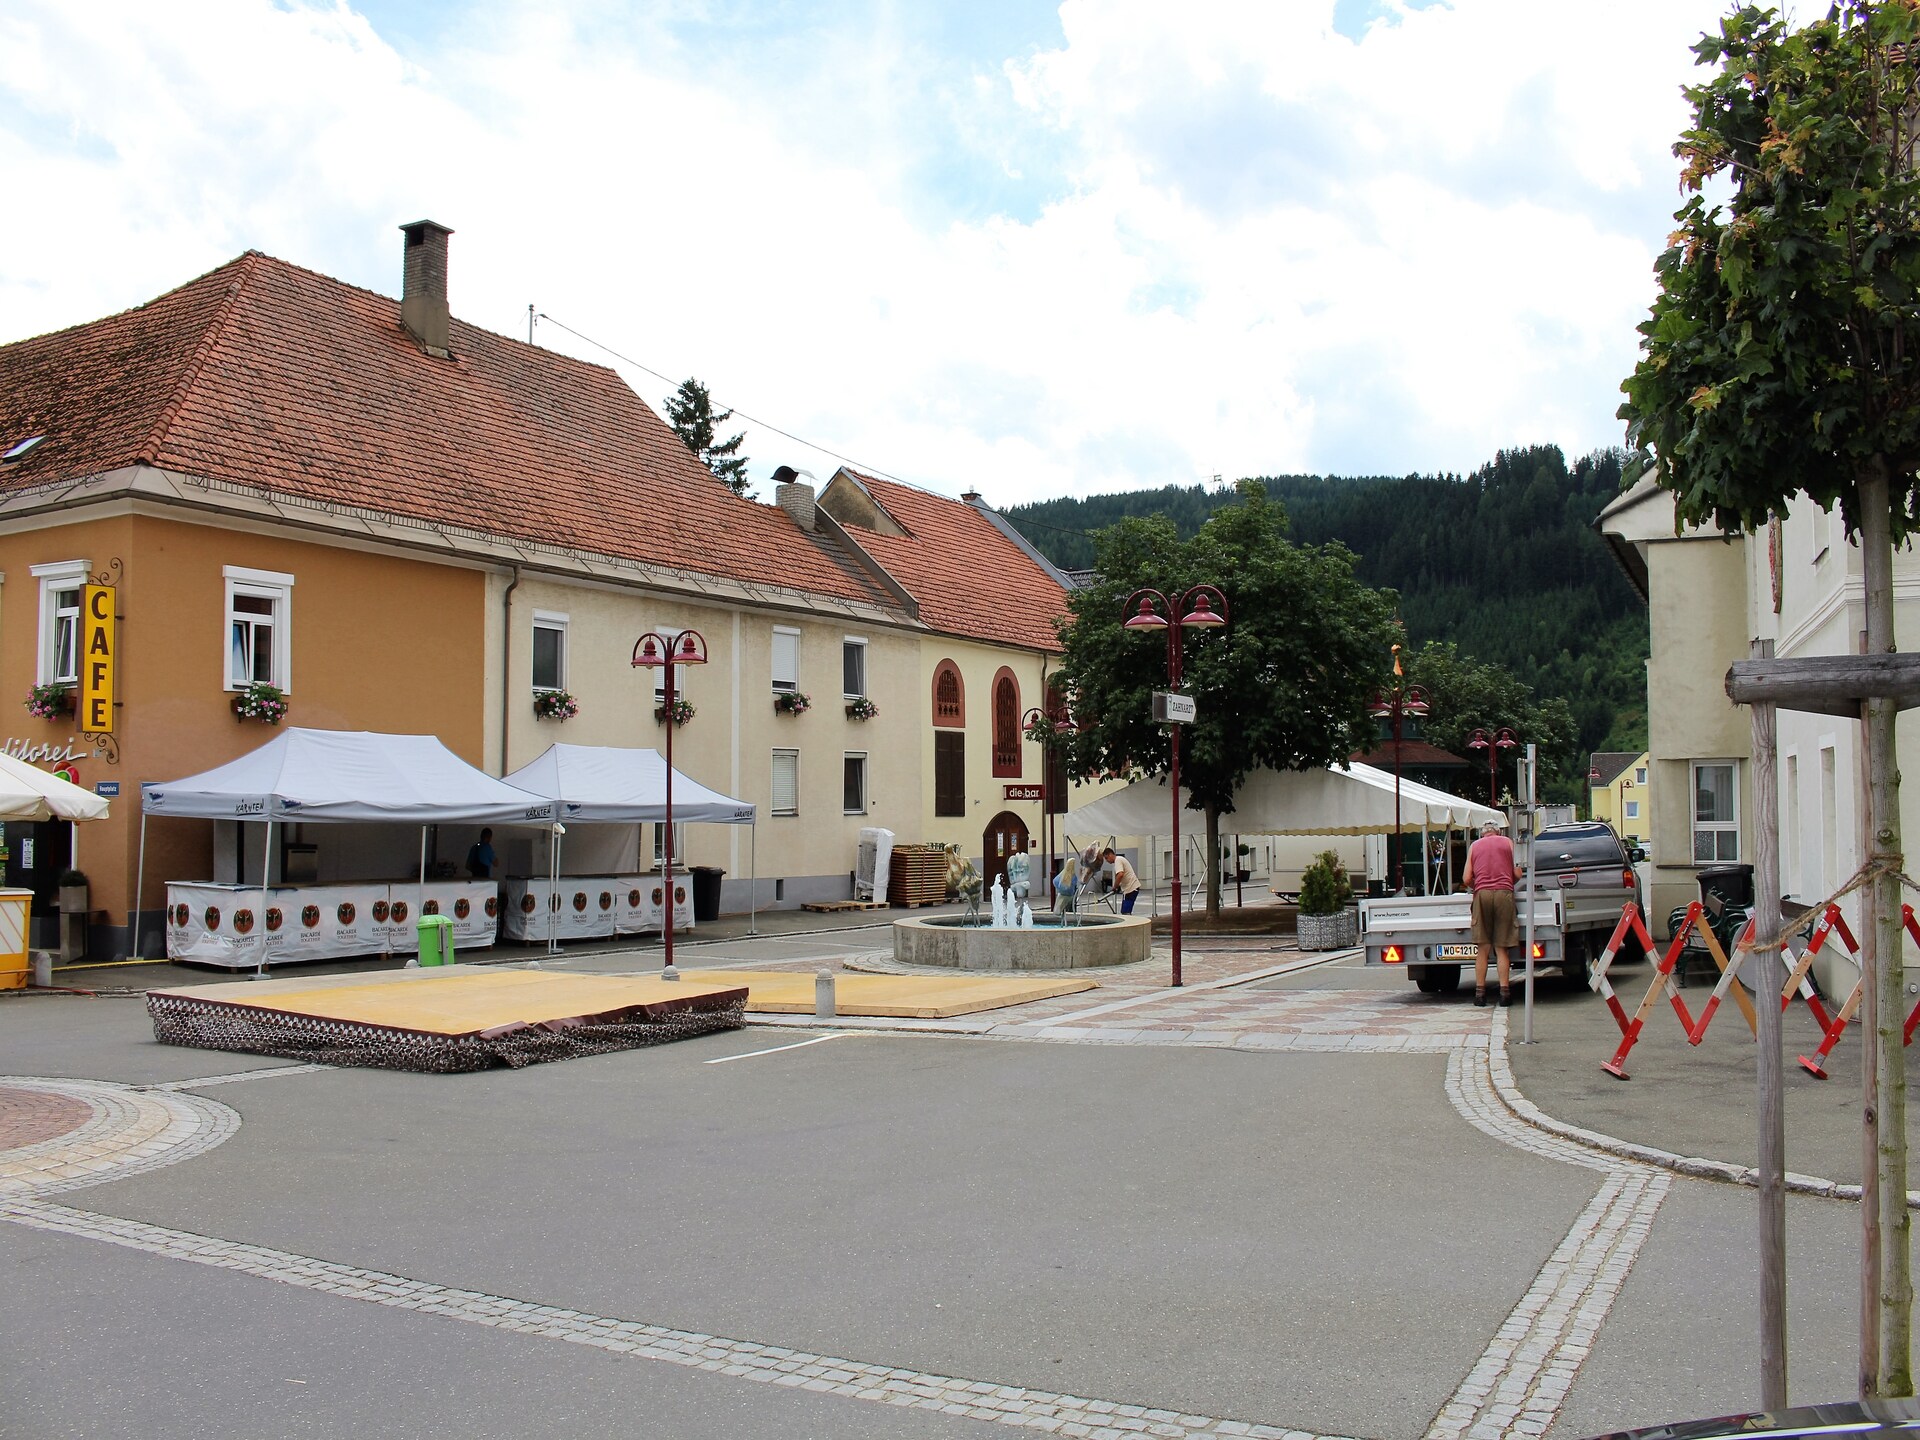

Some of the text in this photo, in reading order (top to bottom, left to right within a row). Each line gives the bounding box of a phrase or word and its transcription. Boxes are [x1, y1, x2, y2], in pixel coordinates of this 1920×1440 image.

[88, 590, 110, 728] CAFE
[99, 785, 118, 793] Hauptplatz
[1443, 946, 1455, 955] WO
